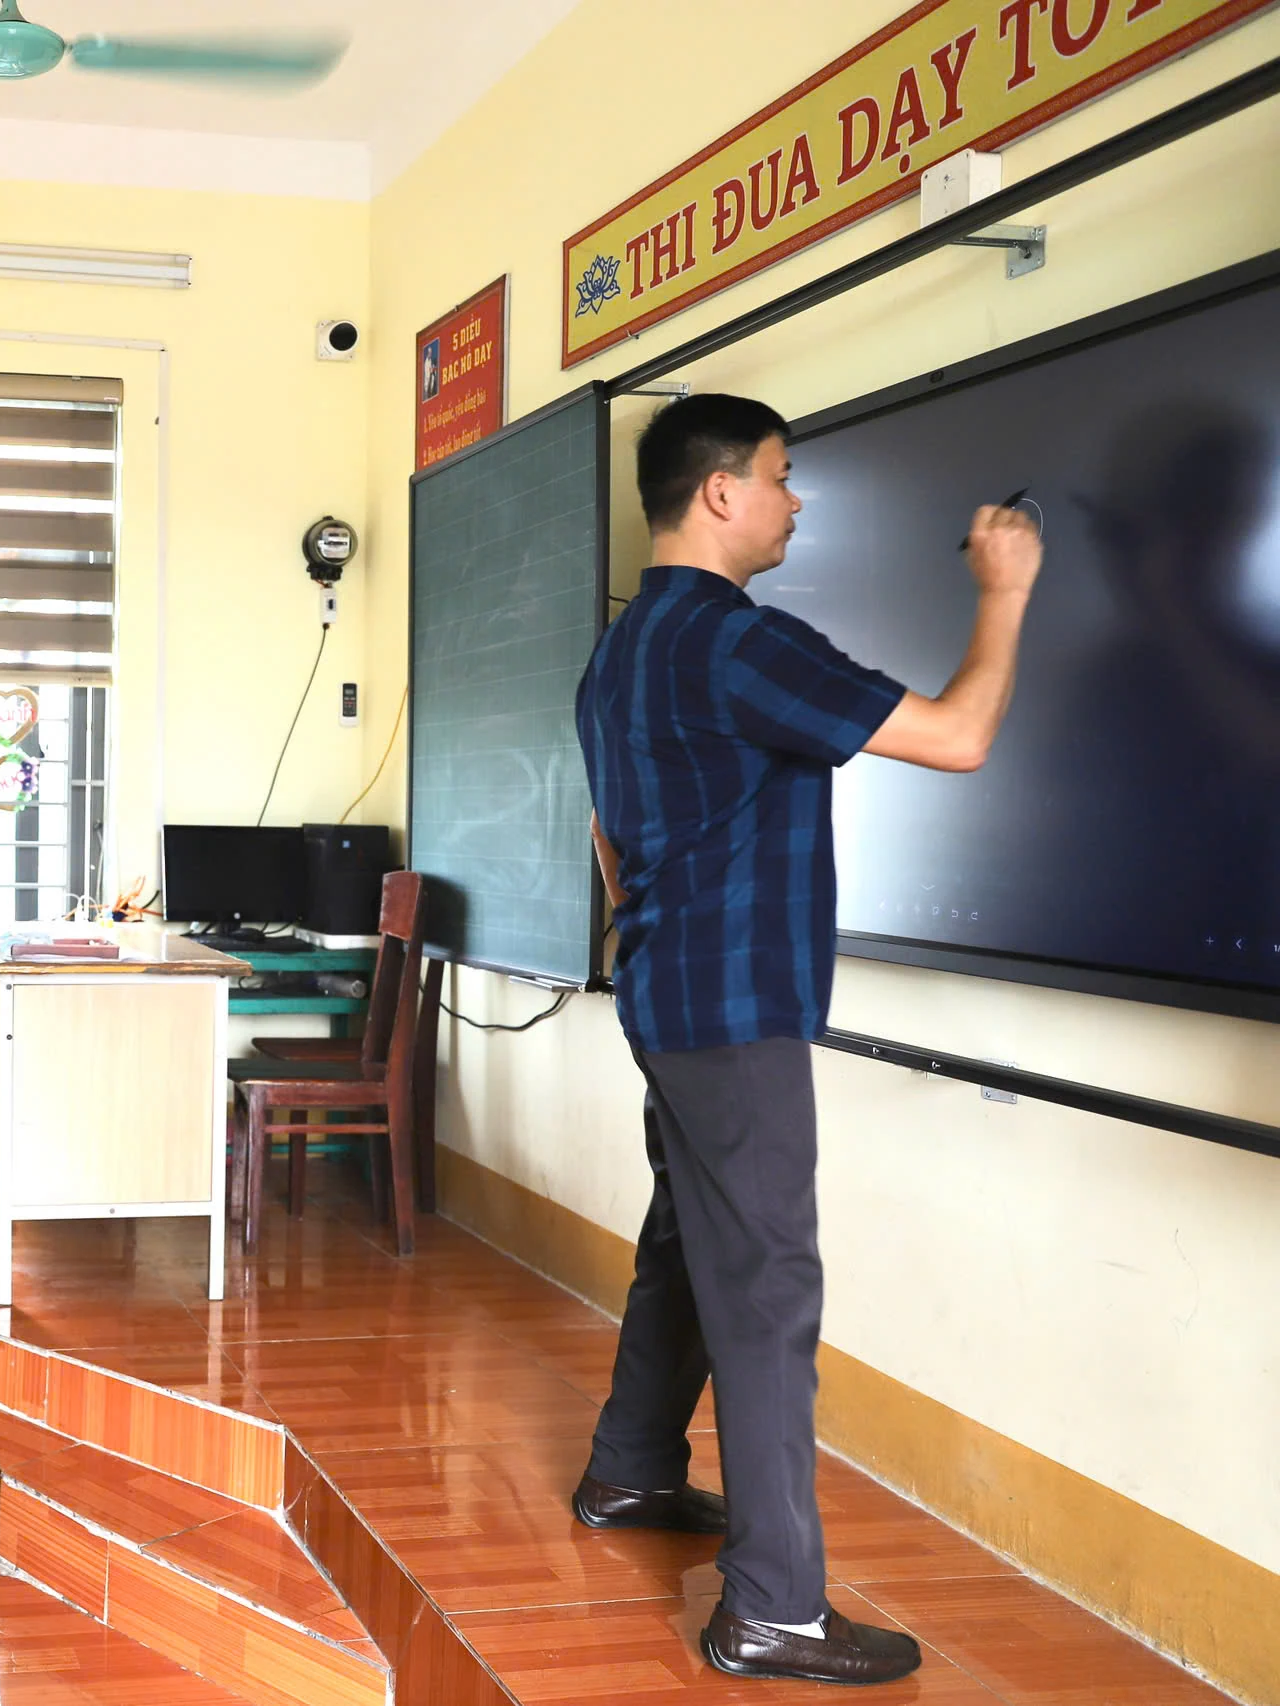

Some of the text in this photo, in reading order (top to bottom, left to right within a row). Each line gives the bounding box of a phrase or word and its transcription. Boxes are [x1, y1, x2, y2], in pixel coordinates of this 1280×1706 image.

[626, 201, 697, 300] THI
[712, 133, 821, 256] ĐUA
[837, 26, 978, 187] DẠY
[452, 313, 481, 351] 5 ĐIỀU
[441, 340, 493, 386] BÁC HỒ DẠY
